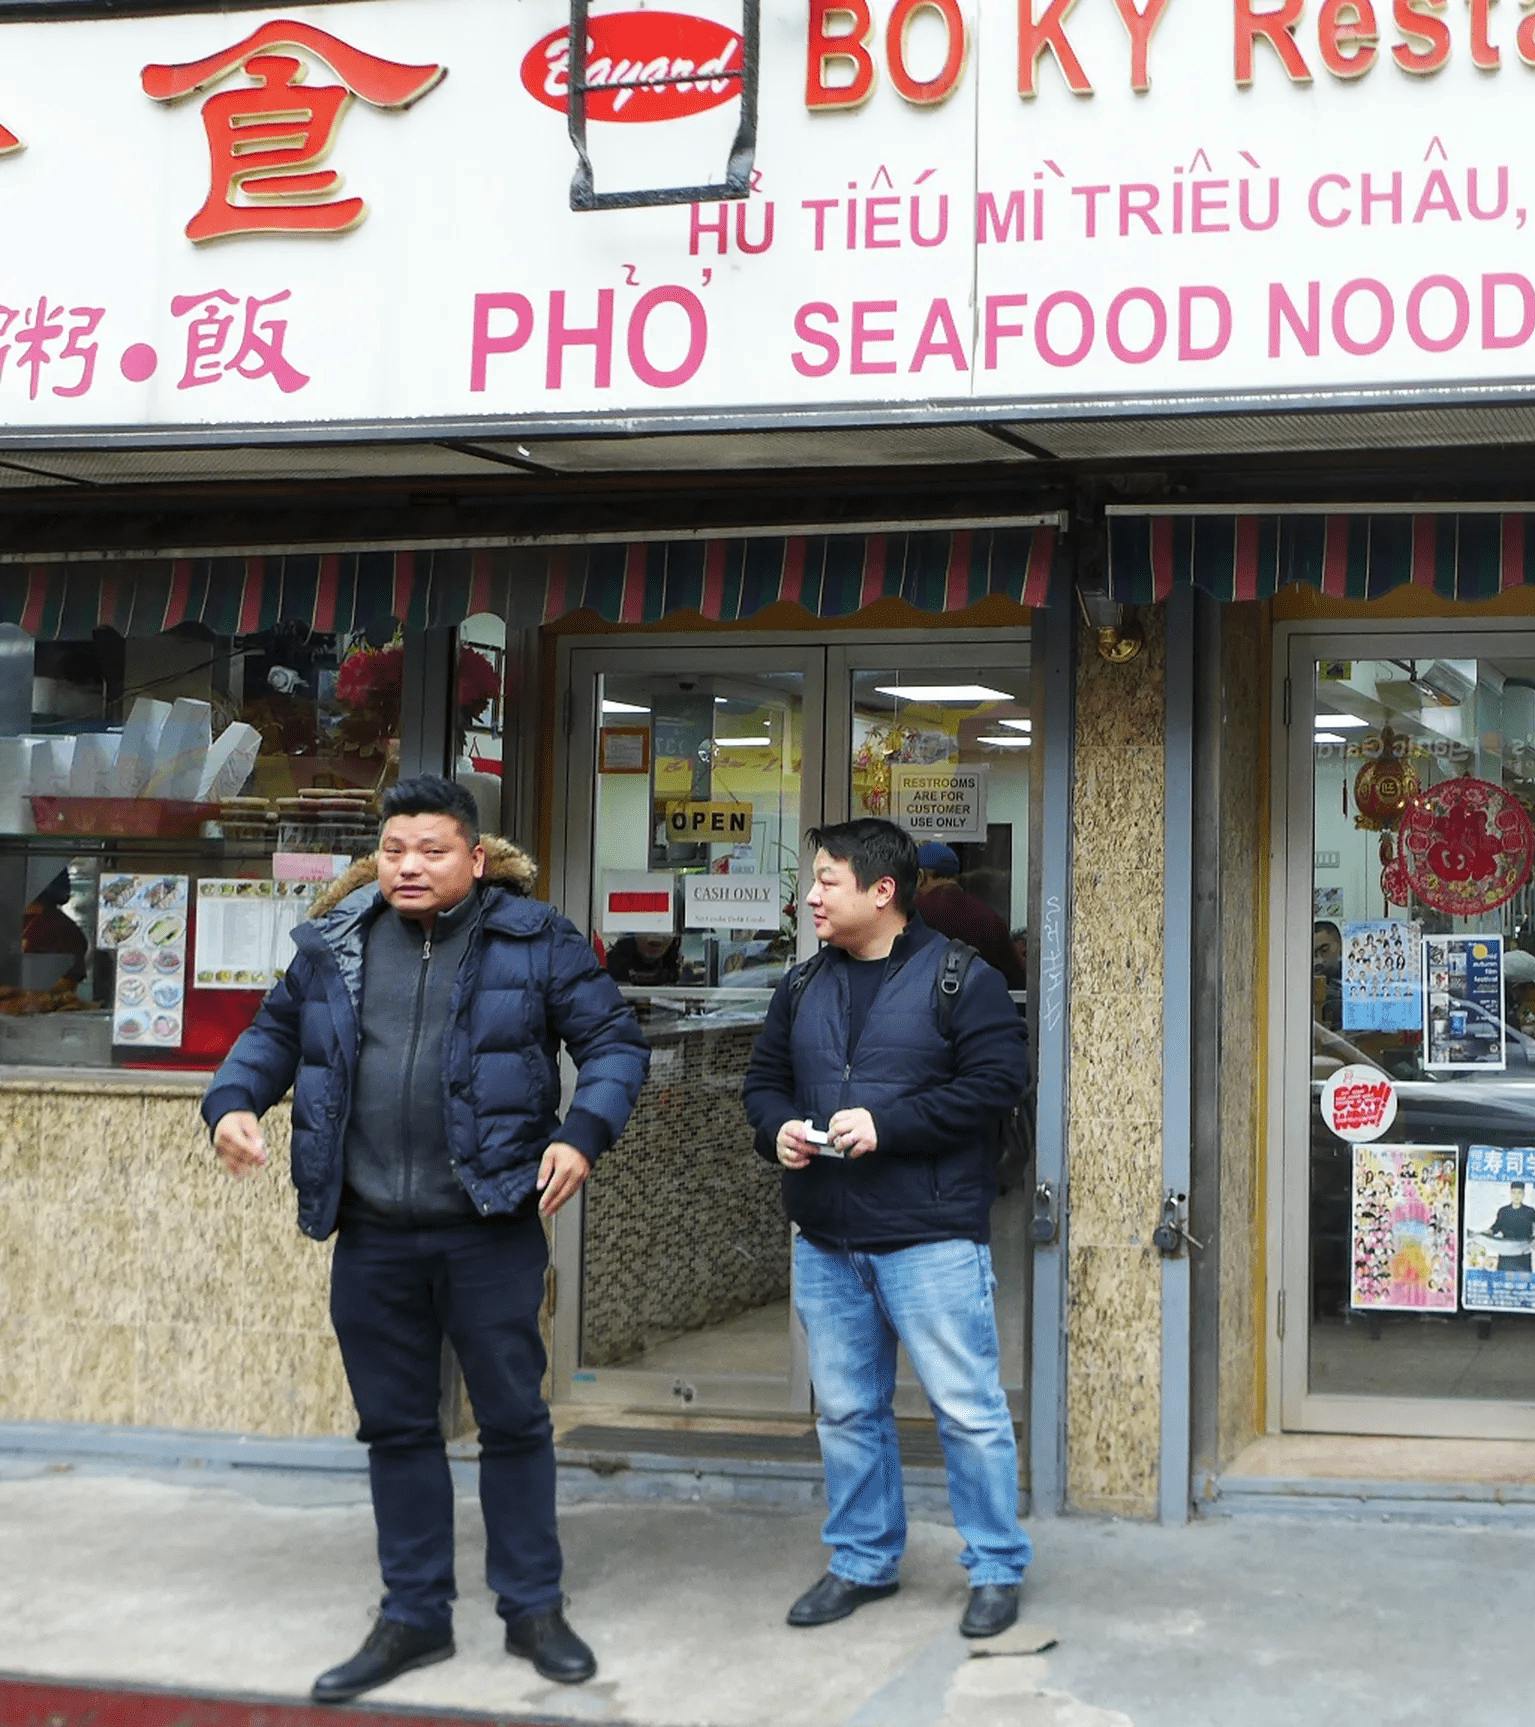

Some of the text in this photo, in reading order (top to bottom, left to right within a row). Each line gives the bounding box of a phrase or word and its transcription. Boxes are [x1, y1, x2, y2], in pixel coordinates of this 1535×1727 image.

[805, 0, 971, 111] BO
[1017, 0, 1172, 98] KY
[544, 35, 738, 112] Bayard
[141, 19, 448, 244] 食
[1308, 136, 1527, 229] CHÂU,
[791, 284, 1233, 378] SEAFOOD
[903, 777, 975, 788] RESTROOMS
[913, 790, 964, 801] ARE FOR
[906, 804, 970, 814] CUSTOMER
[671, 812, 745, 832] OPEN
[910, 817, 966, 828] USE ONLY
[694, 887, 770, 900] CASH ONLY
